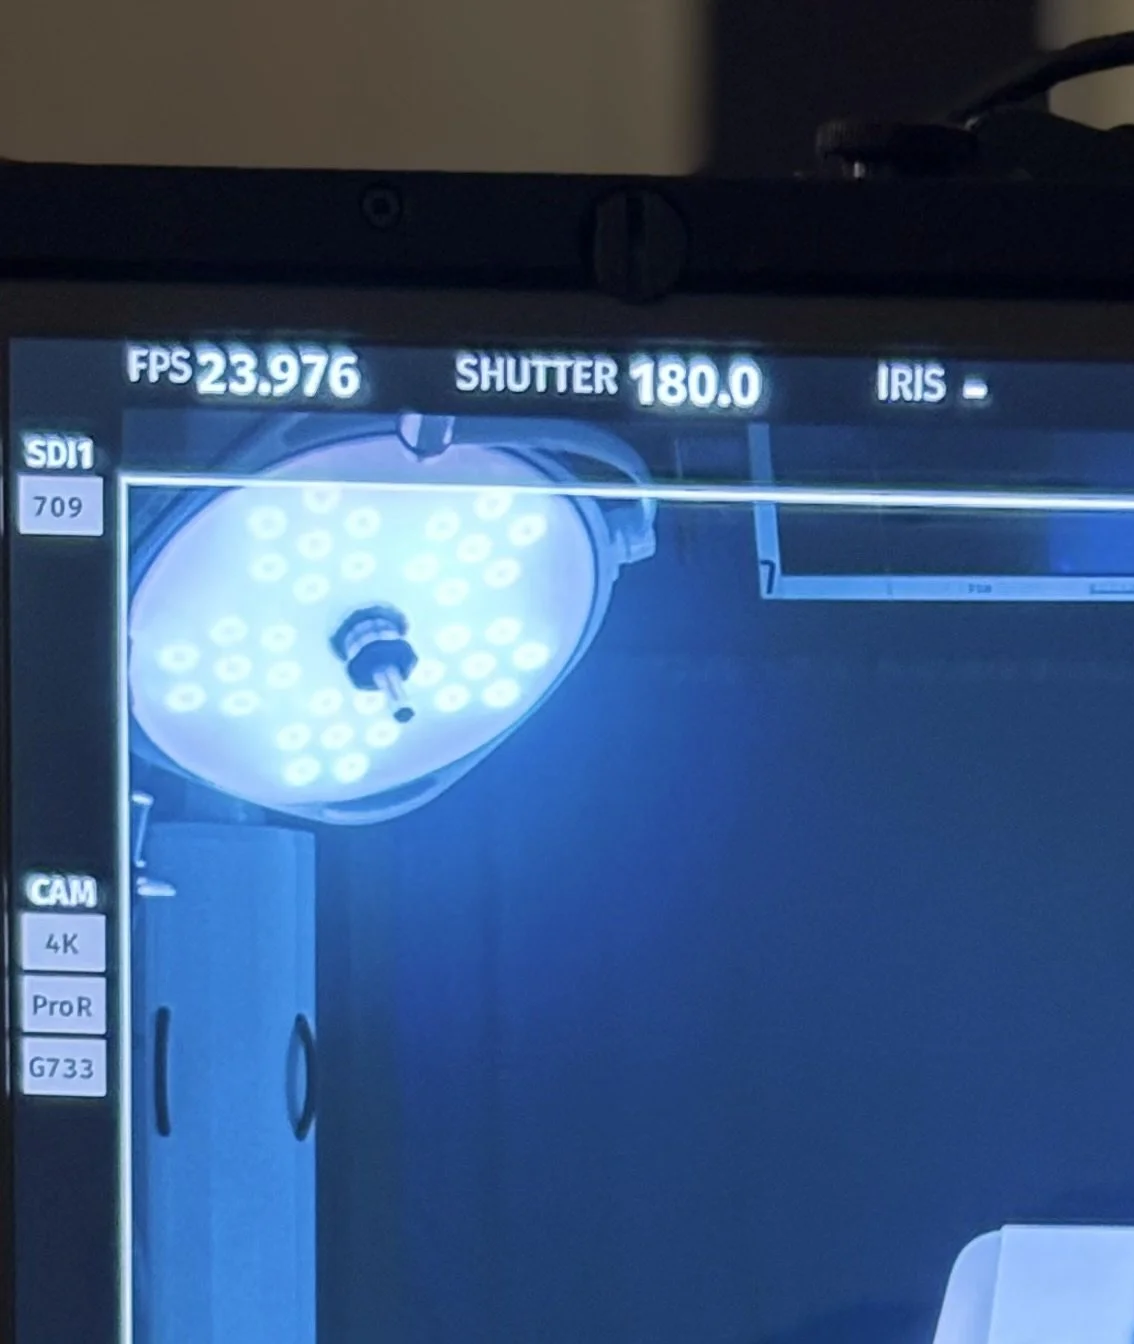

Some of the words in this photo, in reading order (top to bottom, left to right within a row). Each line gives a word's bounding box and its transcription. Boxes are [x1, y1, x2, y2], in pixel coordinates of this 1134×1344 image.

[127, 345, 192, 384] FPS
[198, 349, 361, 396] 23.976
[455, 353, 620, 394] SHUTTER
[629, 357, 762, 408] 180.0
[876, 362, 946, 402] IRIS
[23, 436, 94, 470] SDI1
[32, 495, 83, 519] 709
[26, 873, 98, 907] CAM
[44, 933, 79, 955] 4K
[32, 992, 93, 1018] ProR
[29, 1056, 95, 1081] G733
